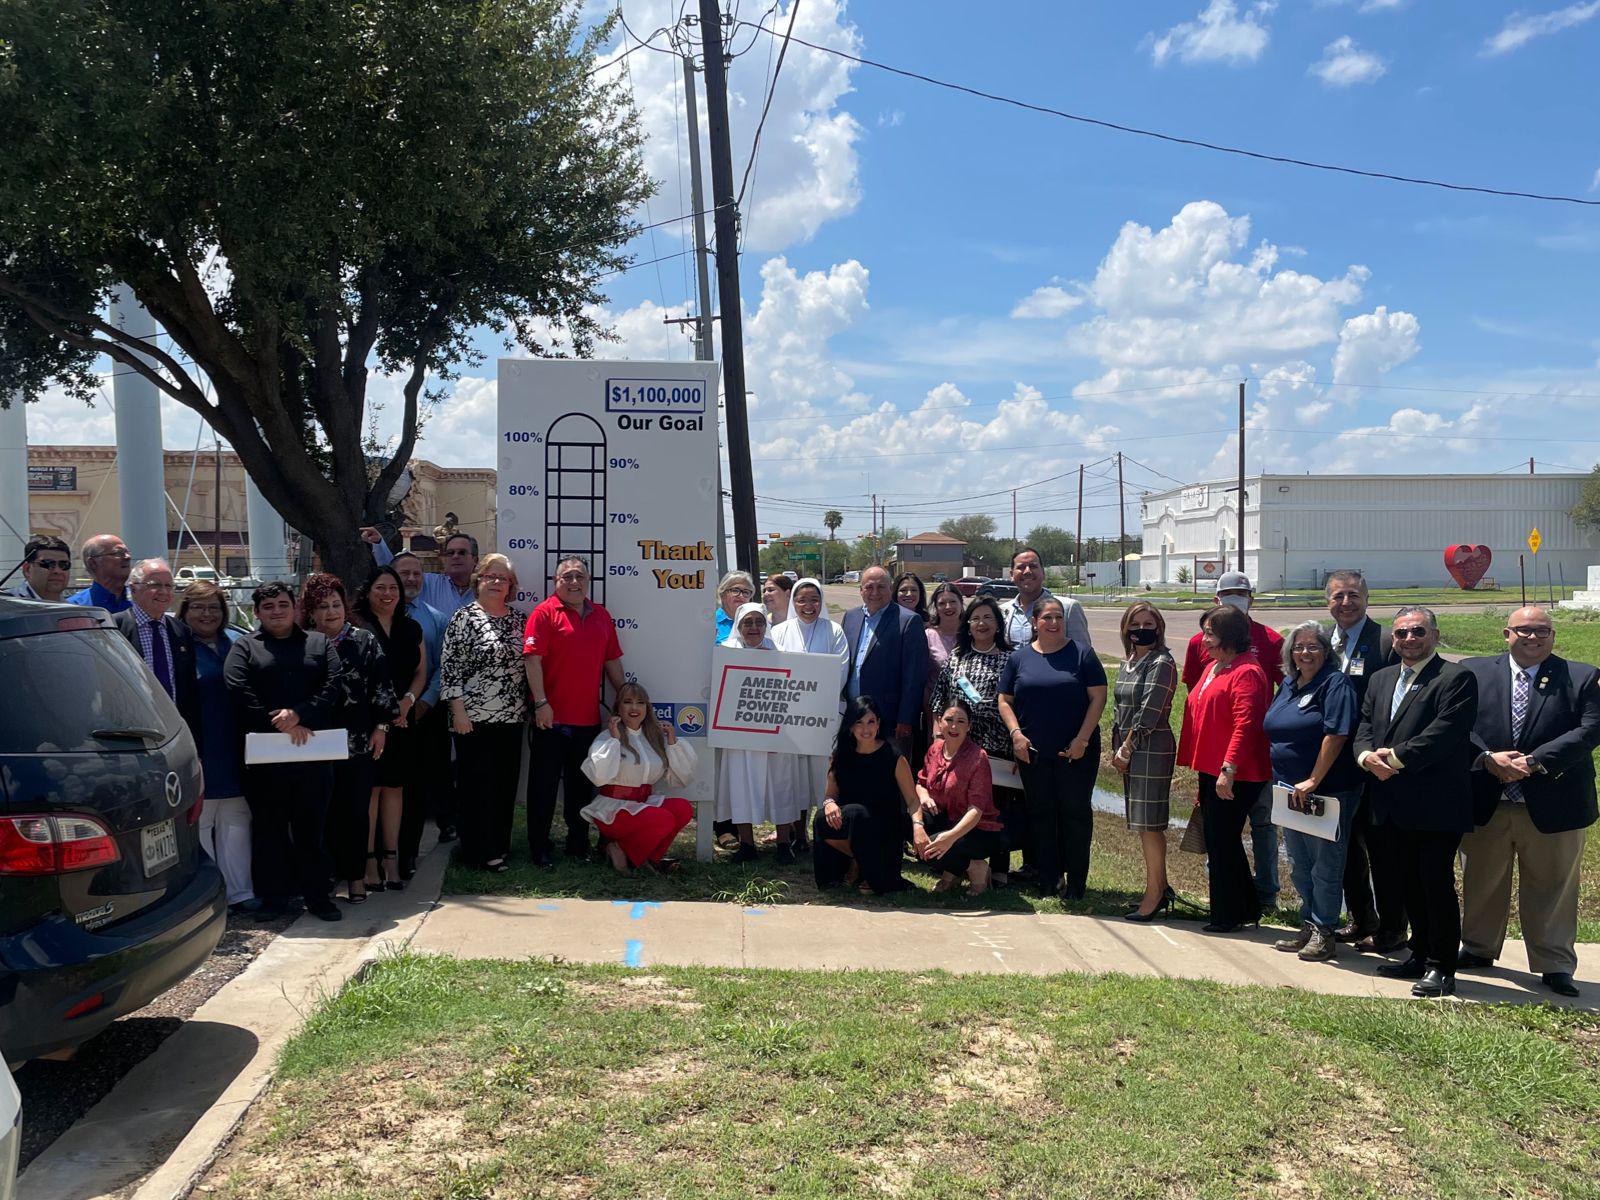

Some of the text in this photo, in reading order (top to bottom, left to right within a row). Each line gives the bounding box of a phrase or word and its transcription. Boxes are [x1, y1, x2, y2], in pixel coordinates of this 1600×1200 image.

[611, 386, 701, 406] $1,100,000
[617, 414, 704, 431] Our Goal
[504, 432, 543, 443] 100%
[609, 458, 640, 470] 90%
[508, 485, 540, 497] 80%
[609, 513, 640, 525] 70%
[508, 538, 540, 550] 60%
[637, 540, 714, 561] Thank
[608, 565, 639, 577] 50%
[652, 569, 705, 590] You!
[516, 591, 539, 602] 0%
[741, 676, 818, 692] AMERICAN
[739, 688, 801, 703] ELECTRIC
[736, 699, 789, 713] POWER
[734, 711, 828, 728] FOUNDATION
